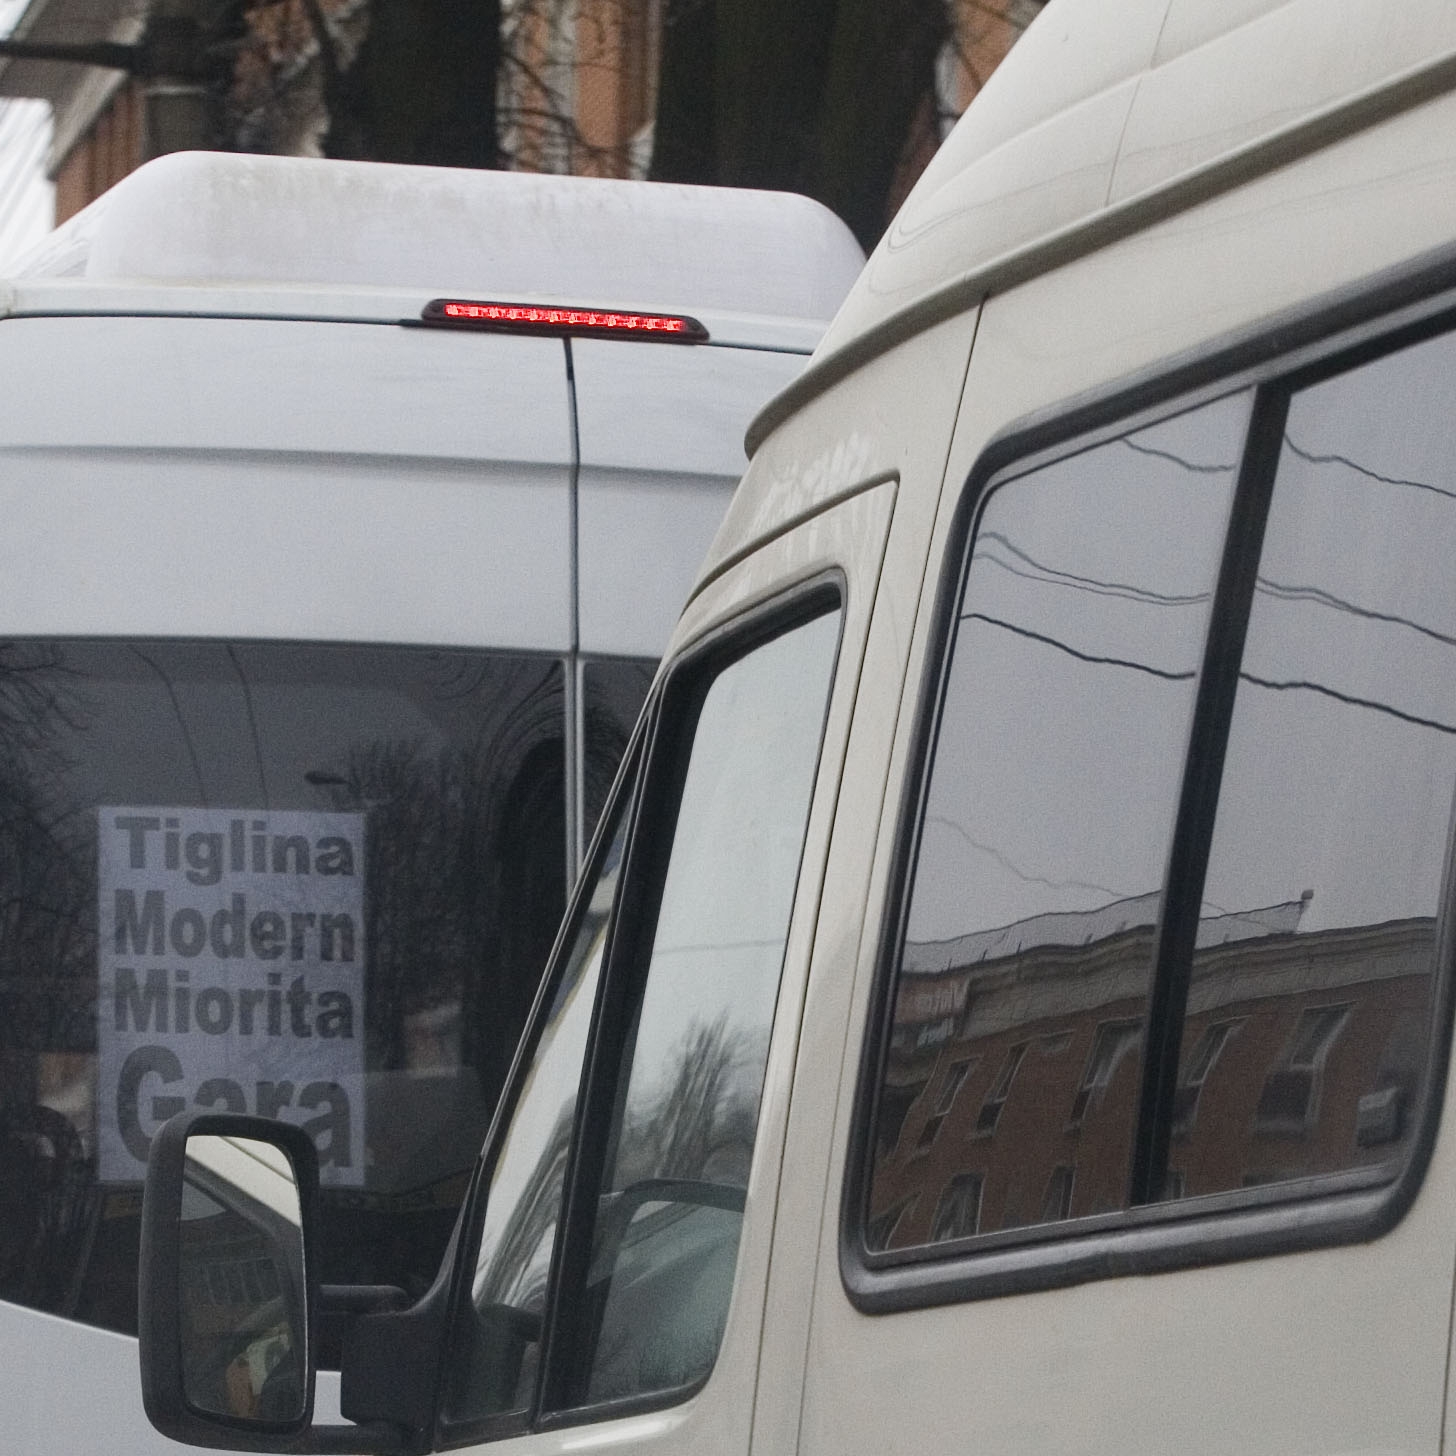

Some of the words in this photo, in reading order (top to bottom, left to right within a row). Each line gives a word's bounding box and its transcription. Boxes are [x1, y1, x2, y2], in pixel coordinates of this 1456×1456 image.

[114, 815, 355, 887] Tiglina
[114, 888, 355, 963] Modern
[113, 967, 355, 1040] Miorita
